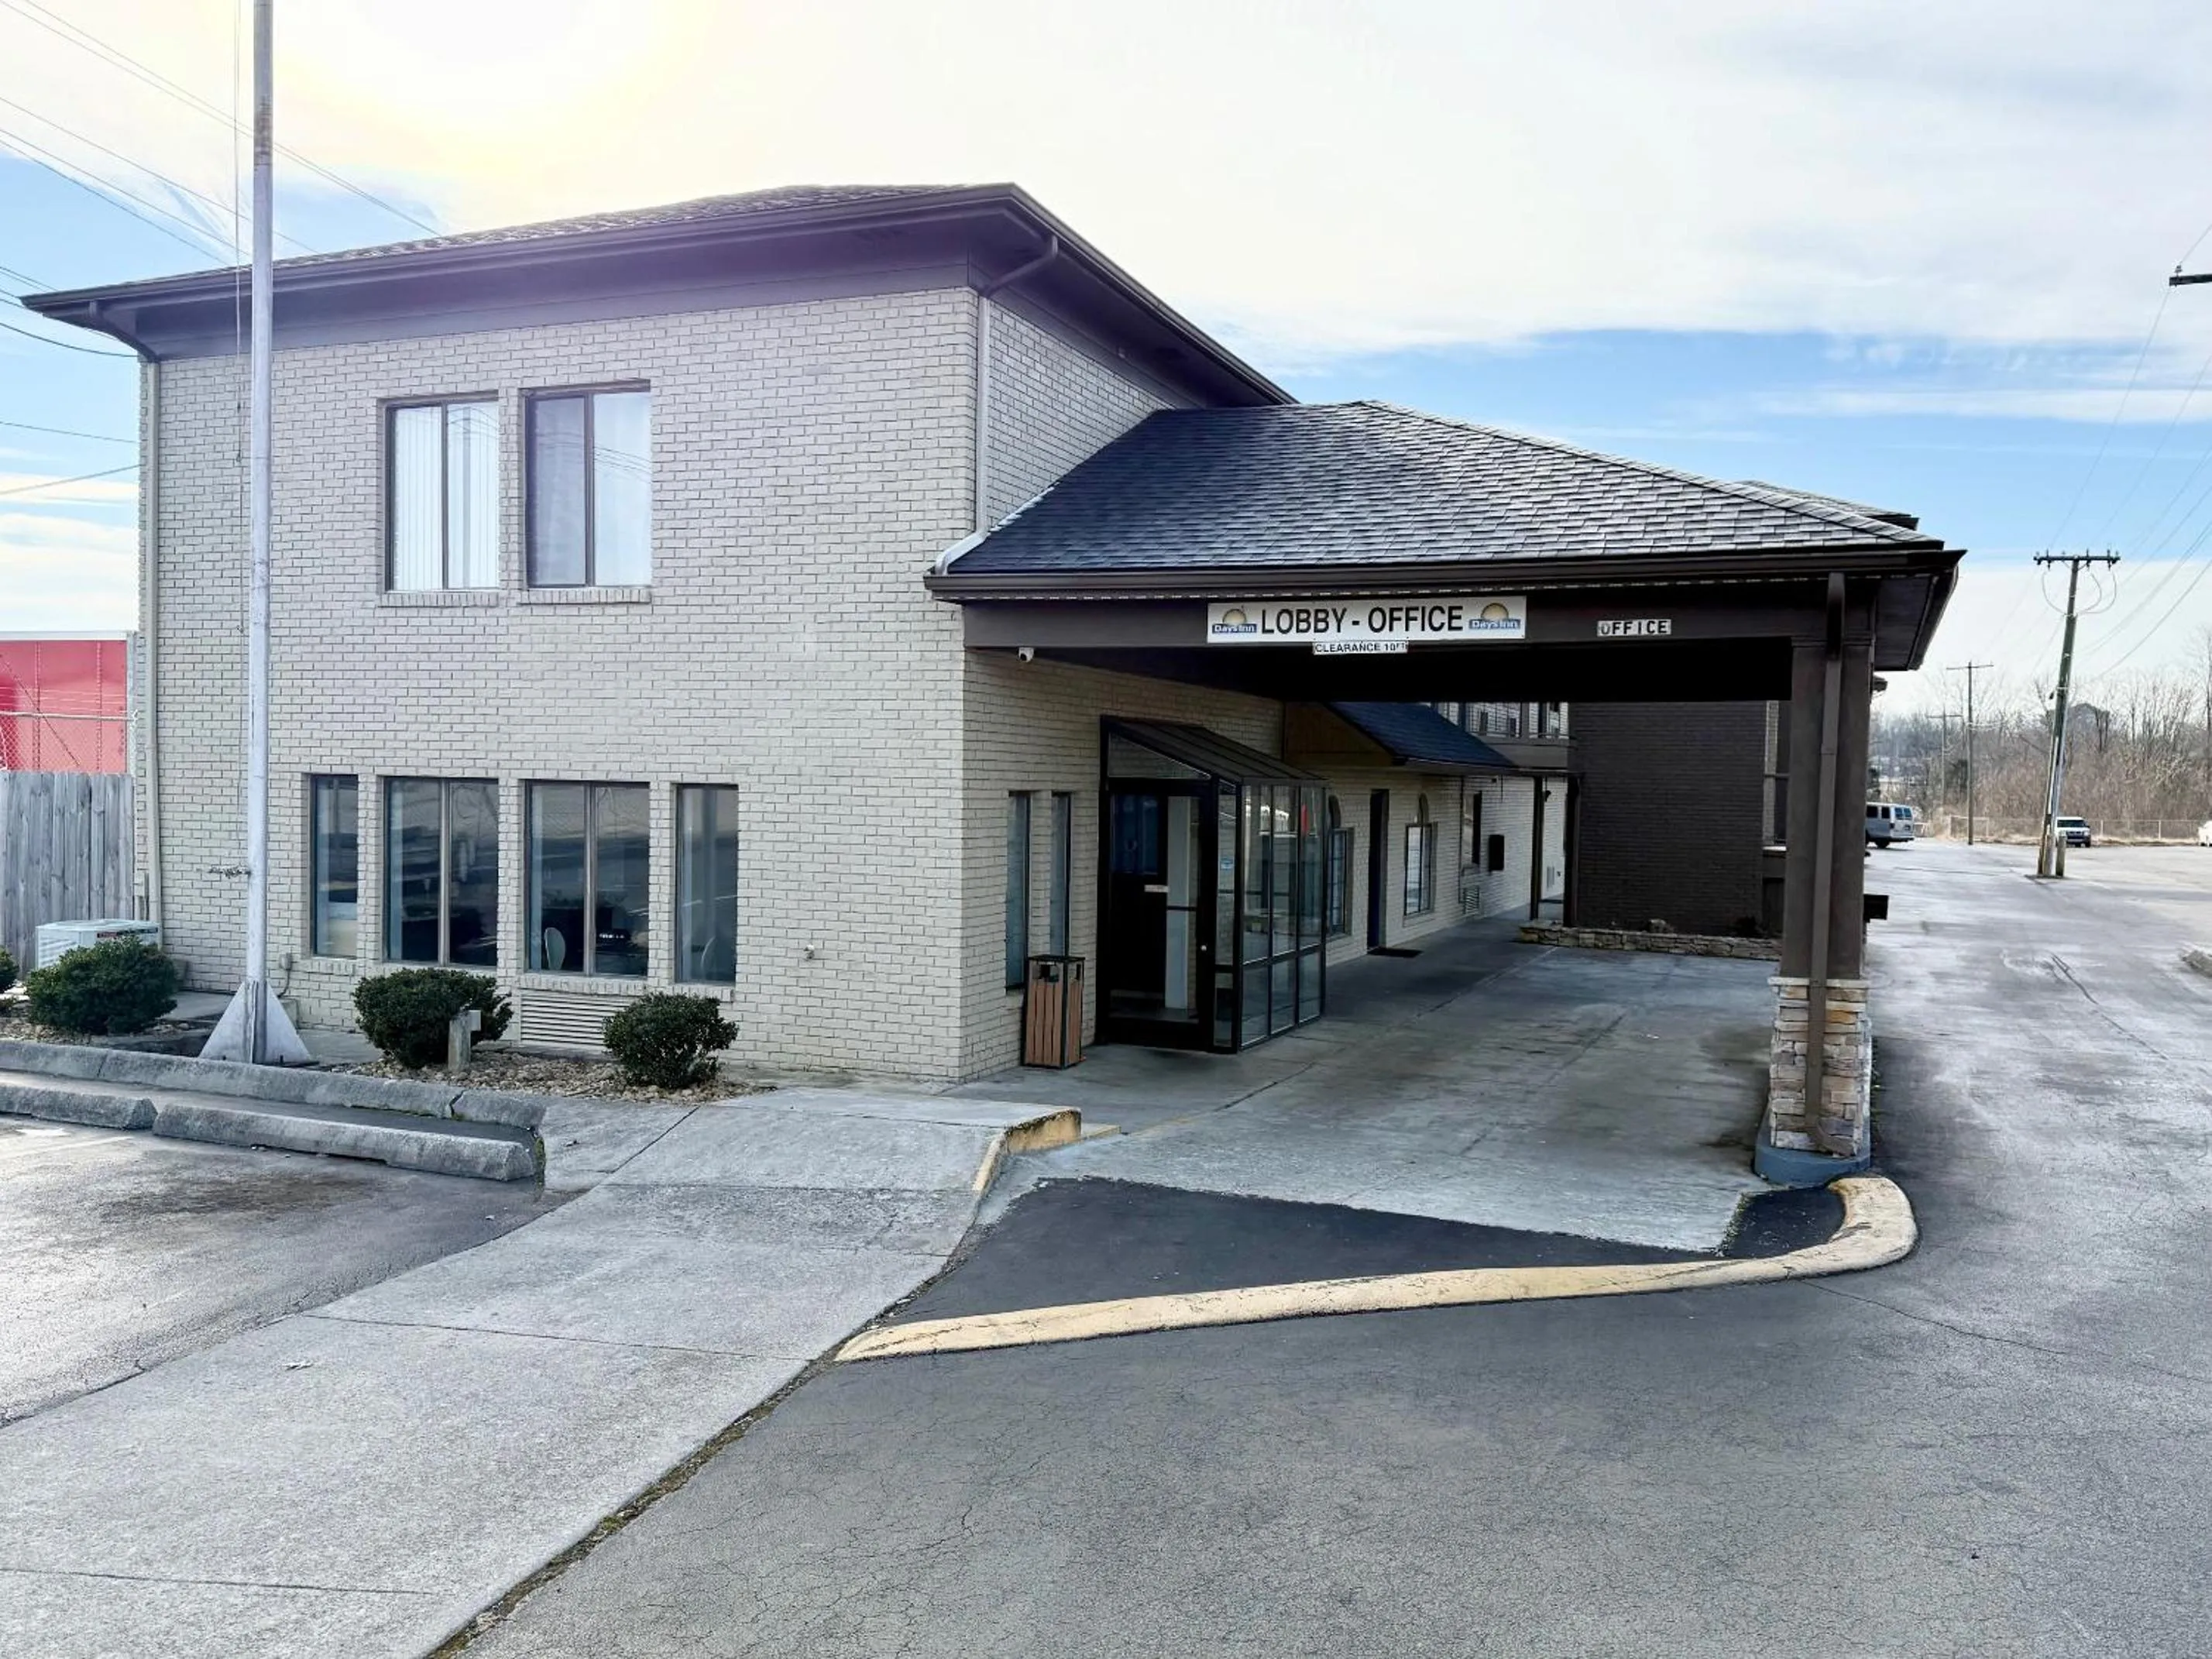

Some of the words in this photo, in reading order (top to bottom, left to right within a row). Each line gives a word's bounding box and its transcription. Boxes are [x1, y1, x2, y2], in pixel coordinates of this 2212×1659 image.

[1262, 608, 1347, 634] LOBBY
[1368, 606, 1463, 633] OFFICE
[1600, 620, 1668, 634] OFFICE
[1315, 643, 1380, 652] CLEARANCE
